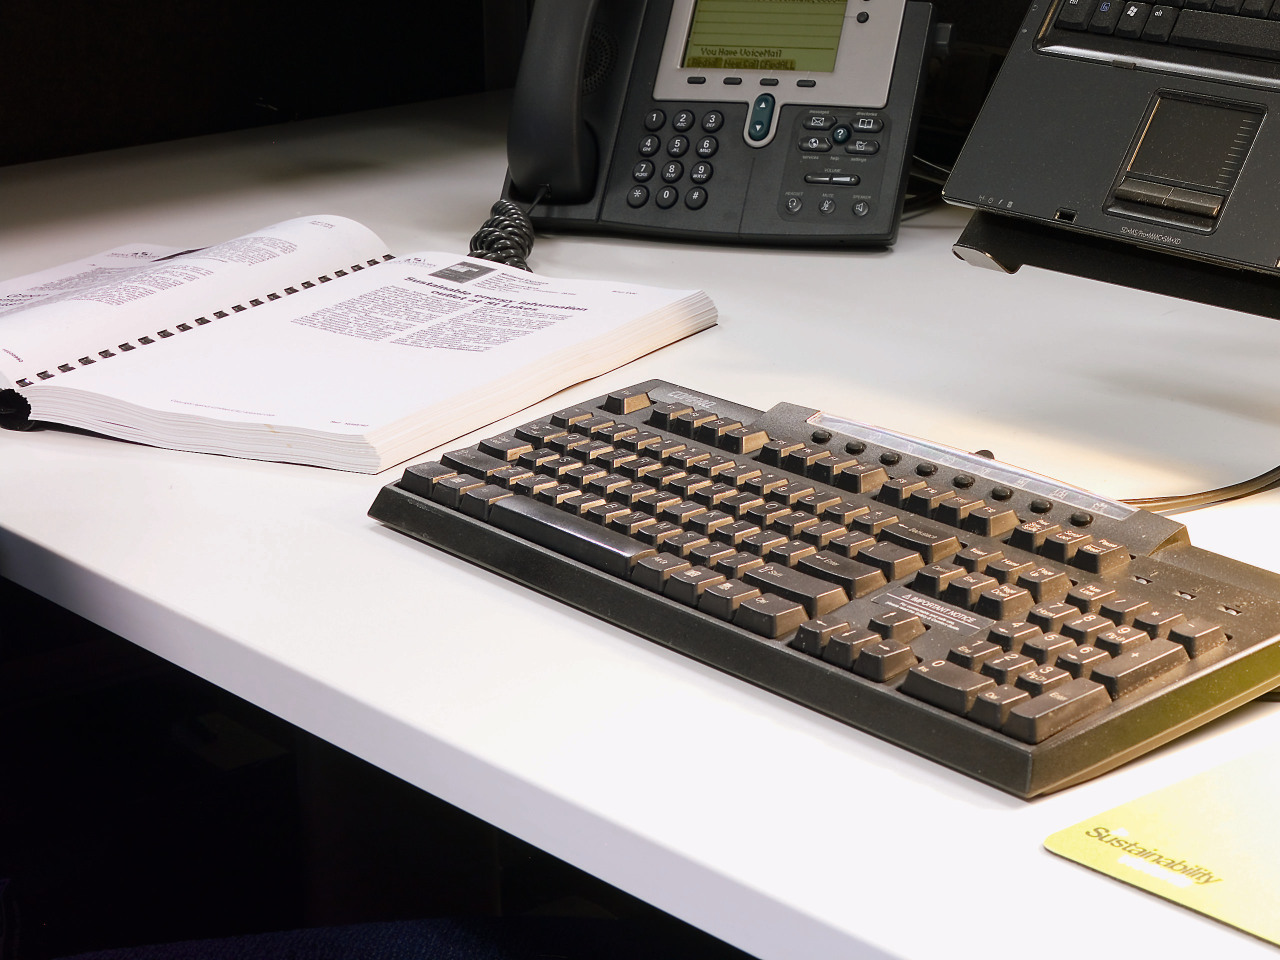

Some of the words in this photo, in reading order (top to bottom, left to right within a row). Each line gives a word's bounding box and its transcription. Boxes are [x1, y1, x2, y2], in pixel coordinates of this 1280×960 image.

[701, 48, 718, 56] You
[652, 114, 657, 122] 1
[680, 114, 686, 122] 2
[710, 114, 716, 123] 3
[646, 138, 652, 146] 4
[674, 140, 680, 148] 5
[703, 140, 710, 148] 6
[640, 164, 646, 172] 7
[668, 164, 675, 173] 8
[698, 166, 704, 174] 9
[664, 190, 670, 198] 0
[404, 276, 472, 296] Sustainable
[474, 294, 514, 304] energy
[518, 300, 588, 312] information
[668, 390, 716, 408] COMPAQ
[911, 596, 949, 614] IMPORTANT
[948, 611, 976, 624] NOTICE
[1085, 826, 1224, 886] Sustainability
